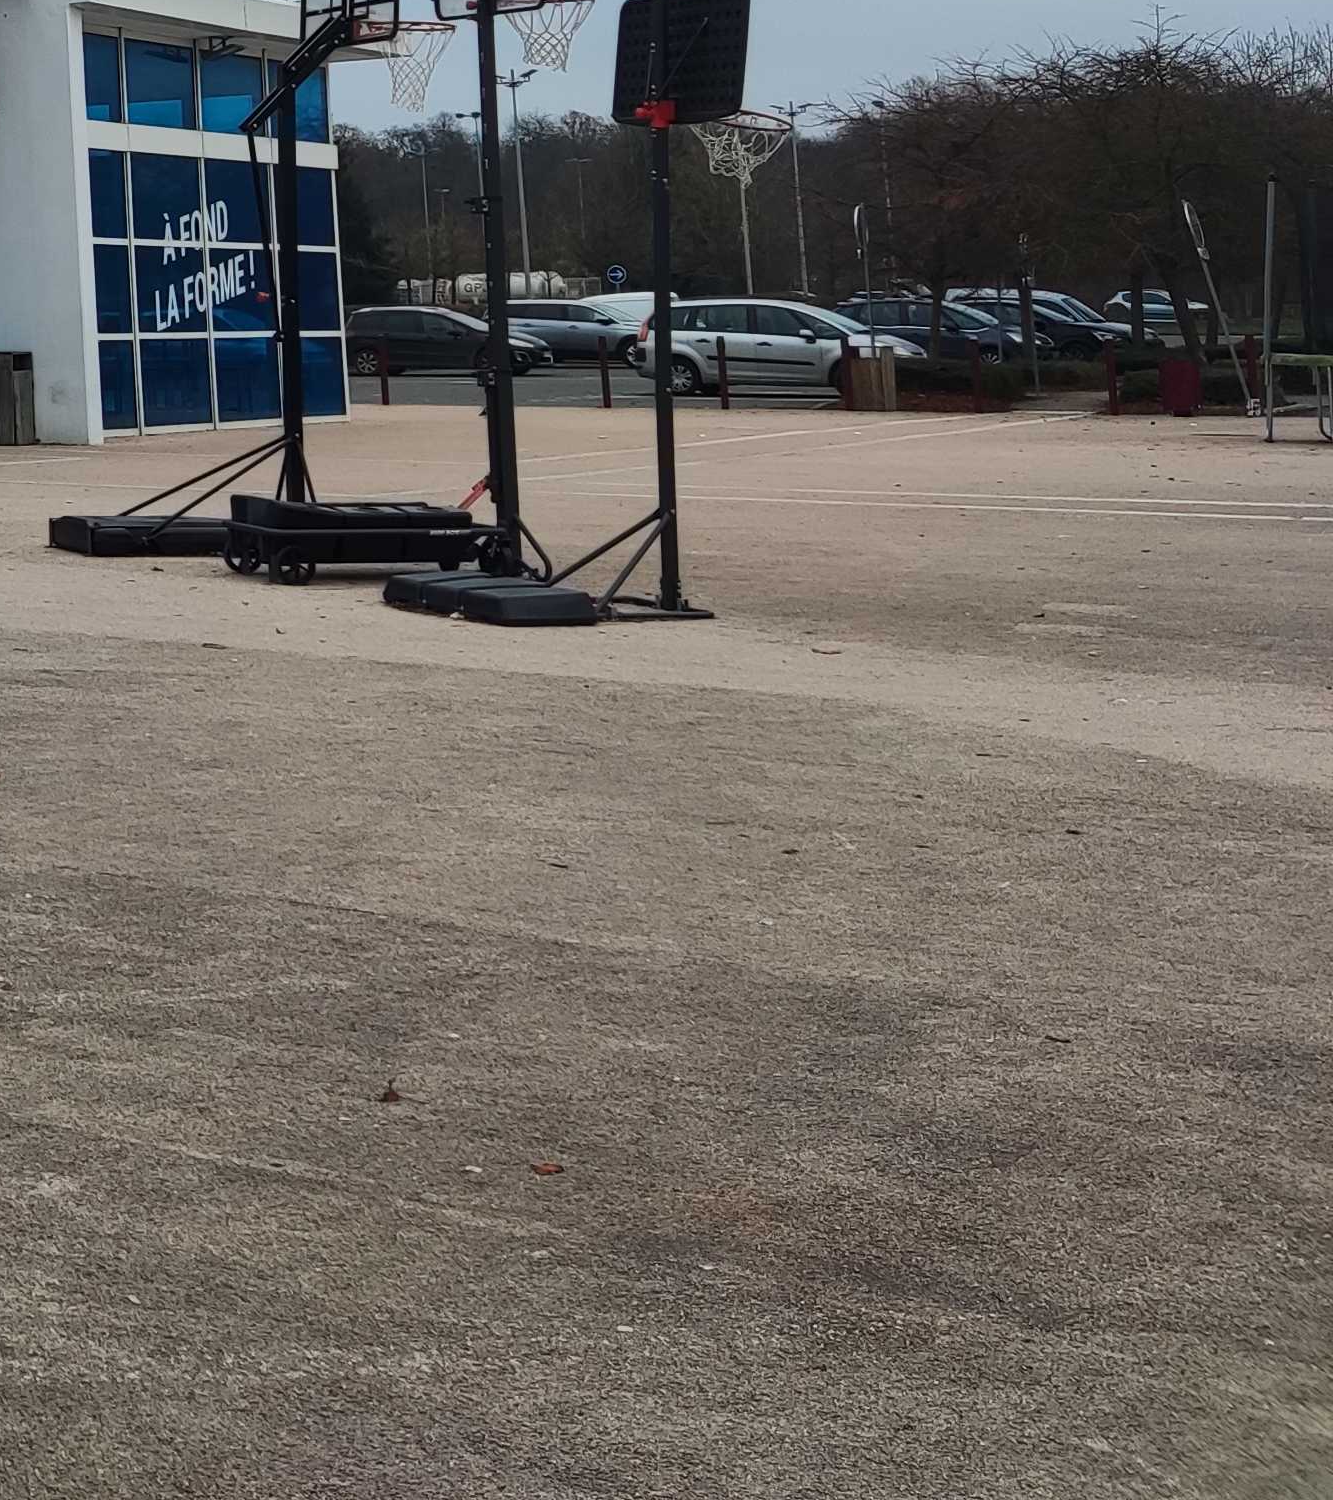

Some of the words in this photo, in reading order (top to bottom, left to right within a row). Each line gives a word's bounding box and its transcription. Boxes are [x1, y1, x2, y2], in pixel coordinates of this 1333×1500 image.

[163, 213, 176, 265] À
[179, 200, 228, 257] FOND
[154, 283, 180, 332] LA
